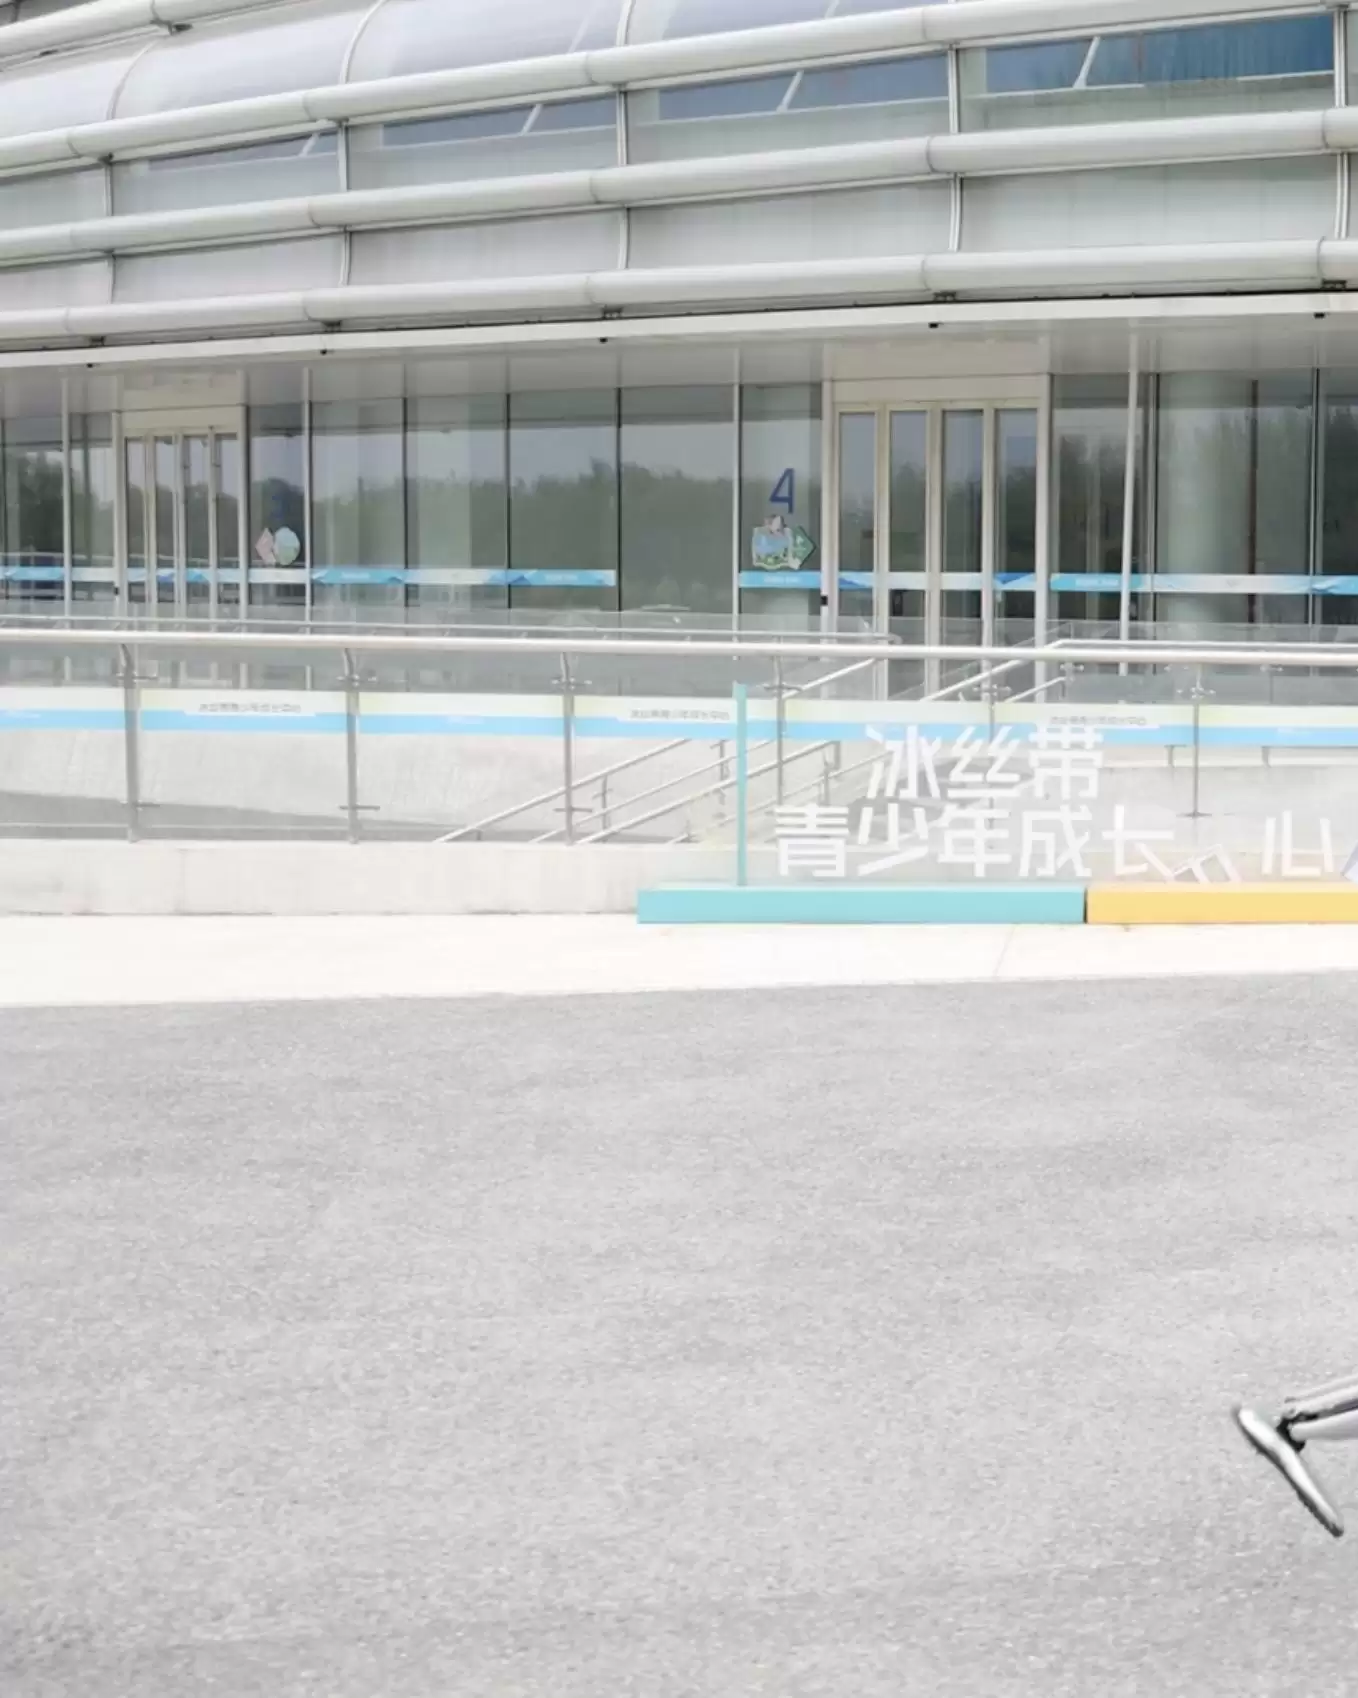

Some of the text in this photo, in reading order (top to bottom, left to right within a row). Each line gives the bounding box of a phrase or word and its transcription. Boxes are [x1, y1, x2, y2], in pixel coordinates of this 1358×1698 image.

[768, 467, 795, 514] 4
[865, 723, 1105, 799] 冰丝带
